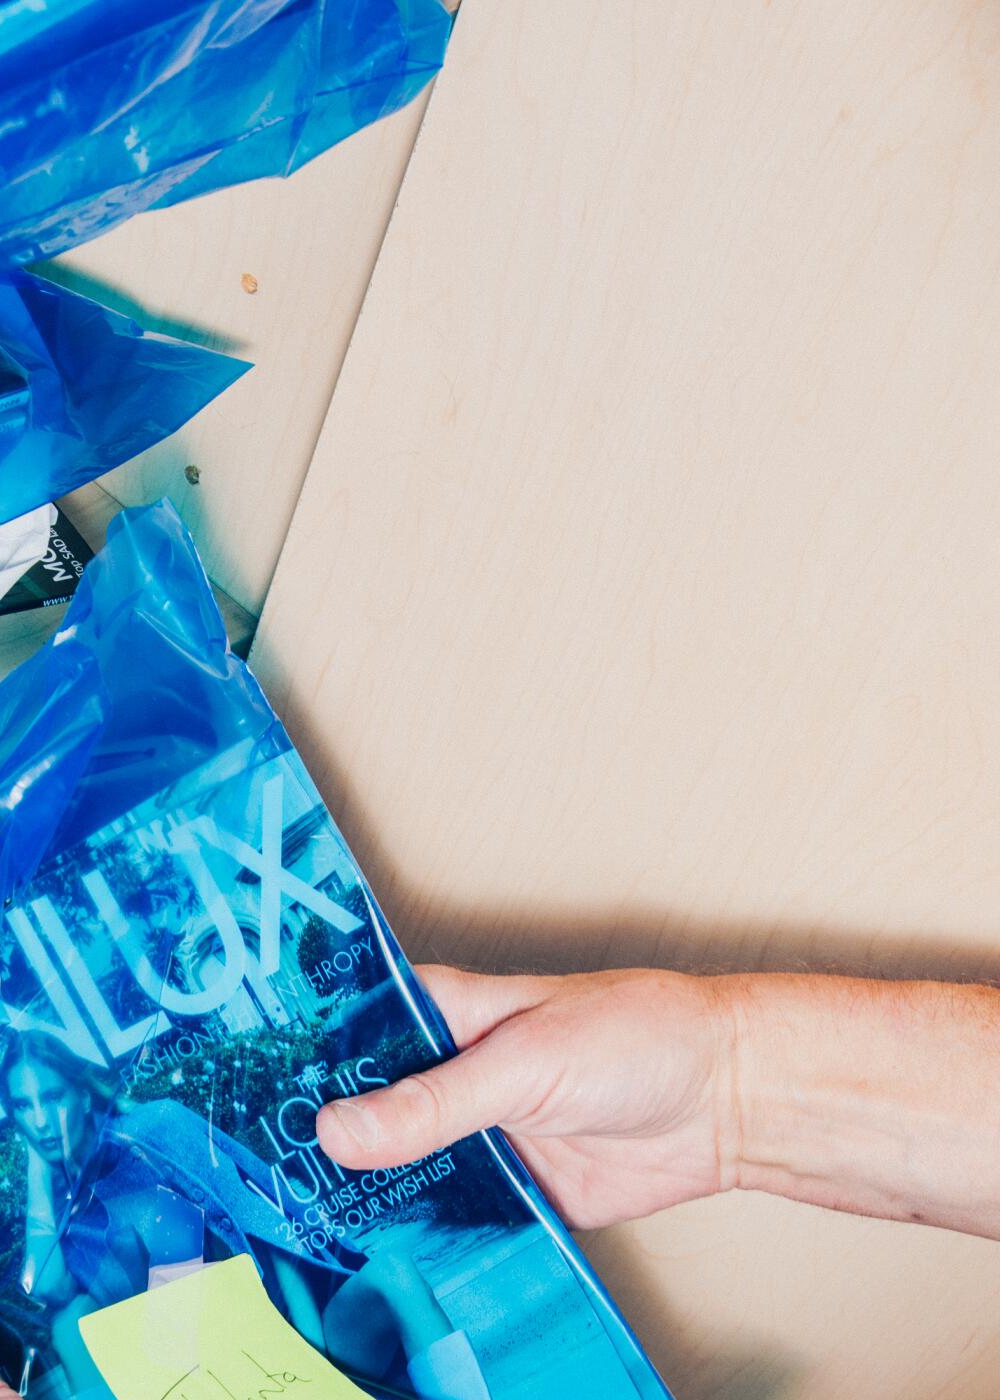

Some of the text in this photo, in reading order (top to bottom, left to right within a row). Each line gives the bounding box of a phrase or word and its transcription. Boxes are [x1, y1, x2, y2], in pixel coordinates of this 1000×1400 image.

[292, 1059, 334, 1095] THE
[298, 1151, 459, 1257] TOPS OUR WISH LIST
[300, 1181, 363, 1229] CRUISE
